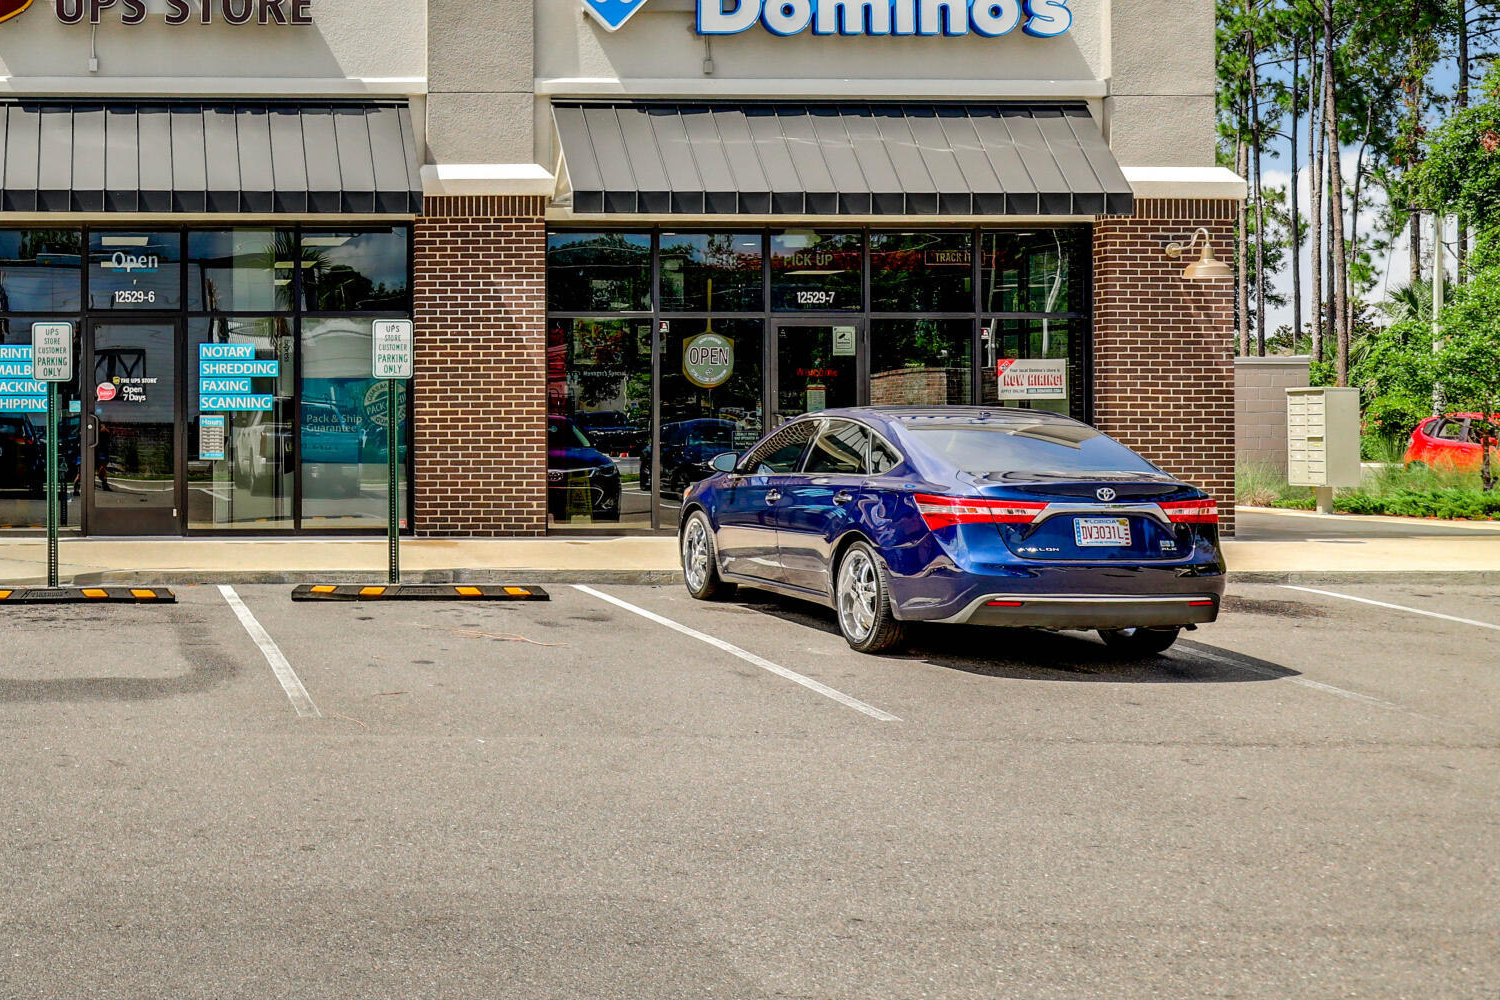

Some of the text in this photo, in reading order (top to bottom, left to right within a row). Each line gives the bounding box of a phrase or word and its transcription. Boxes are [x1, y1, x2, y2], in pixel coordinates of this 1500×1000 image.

[111, 251, 159, 273] Open
[783, 253, 834, 266] PICK UP
[935, 252, 963, 263] TRACK
[114, 290, 156, 303] 12529-6
[796, 291, 836, 304] 12529-7
[45, 328, 60, 336] UPS
[385, 325, 401, 333] UPS
[44, 337, 61, 345] STORE
[384, 334, 402, 342] STORE
[37, 346, 67, 354] CUSTOMER
[202, 346, 252, 357] NOTARY
[37, 357, 68, 366] PARKING
[377, 353, 409, 363] PARKING
[689, 346, 730, 366] OPEN
[43, 367, 62, 377] ONLY
[202, 363, 276, 375] SHREDDING
[383, 364, 403, 374] ONLY
[202, 380, 249, 392] FAXING
[1003, 374, 1063, 387] NOW HIRING!
[122, 385, 143, 394] Open
[122, 393, 128, 401] 7
[128, 393, 146, 403] Days
[200, 396, 271, 409] SCANNING
[306, 414, 363, 426] Pack & Ship
[306, 424, 358, 433] Guarantee
[1081, 525, 1125, 540] DV3031L
